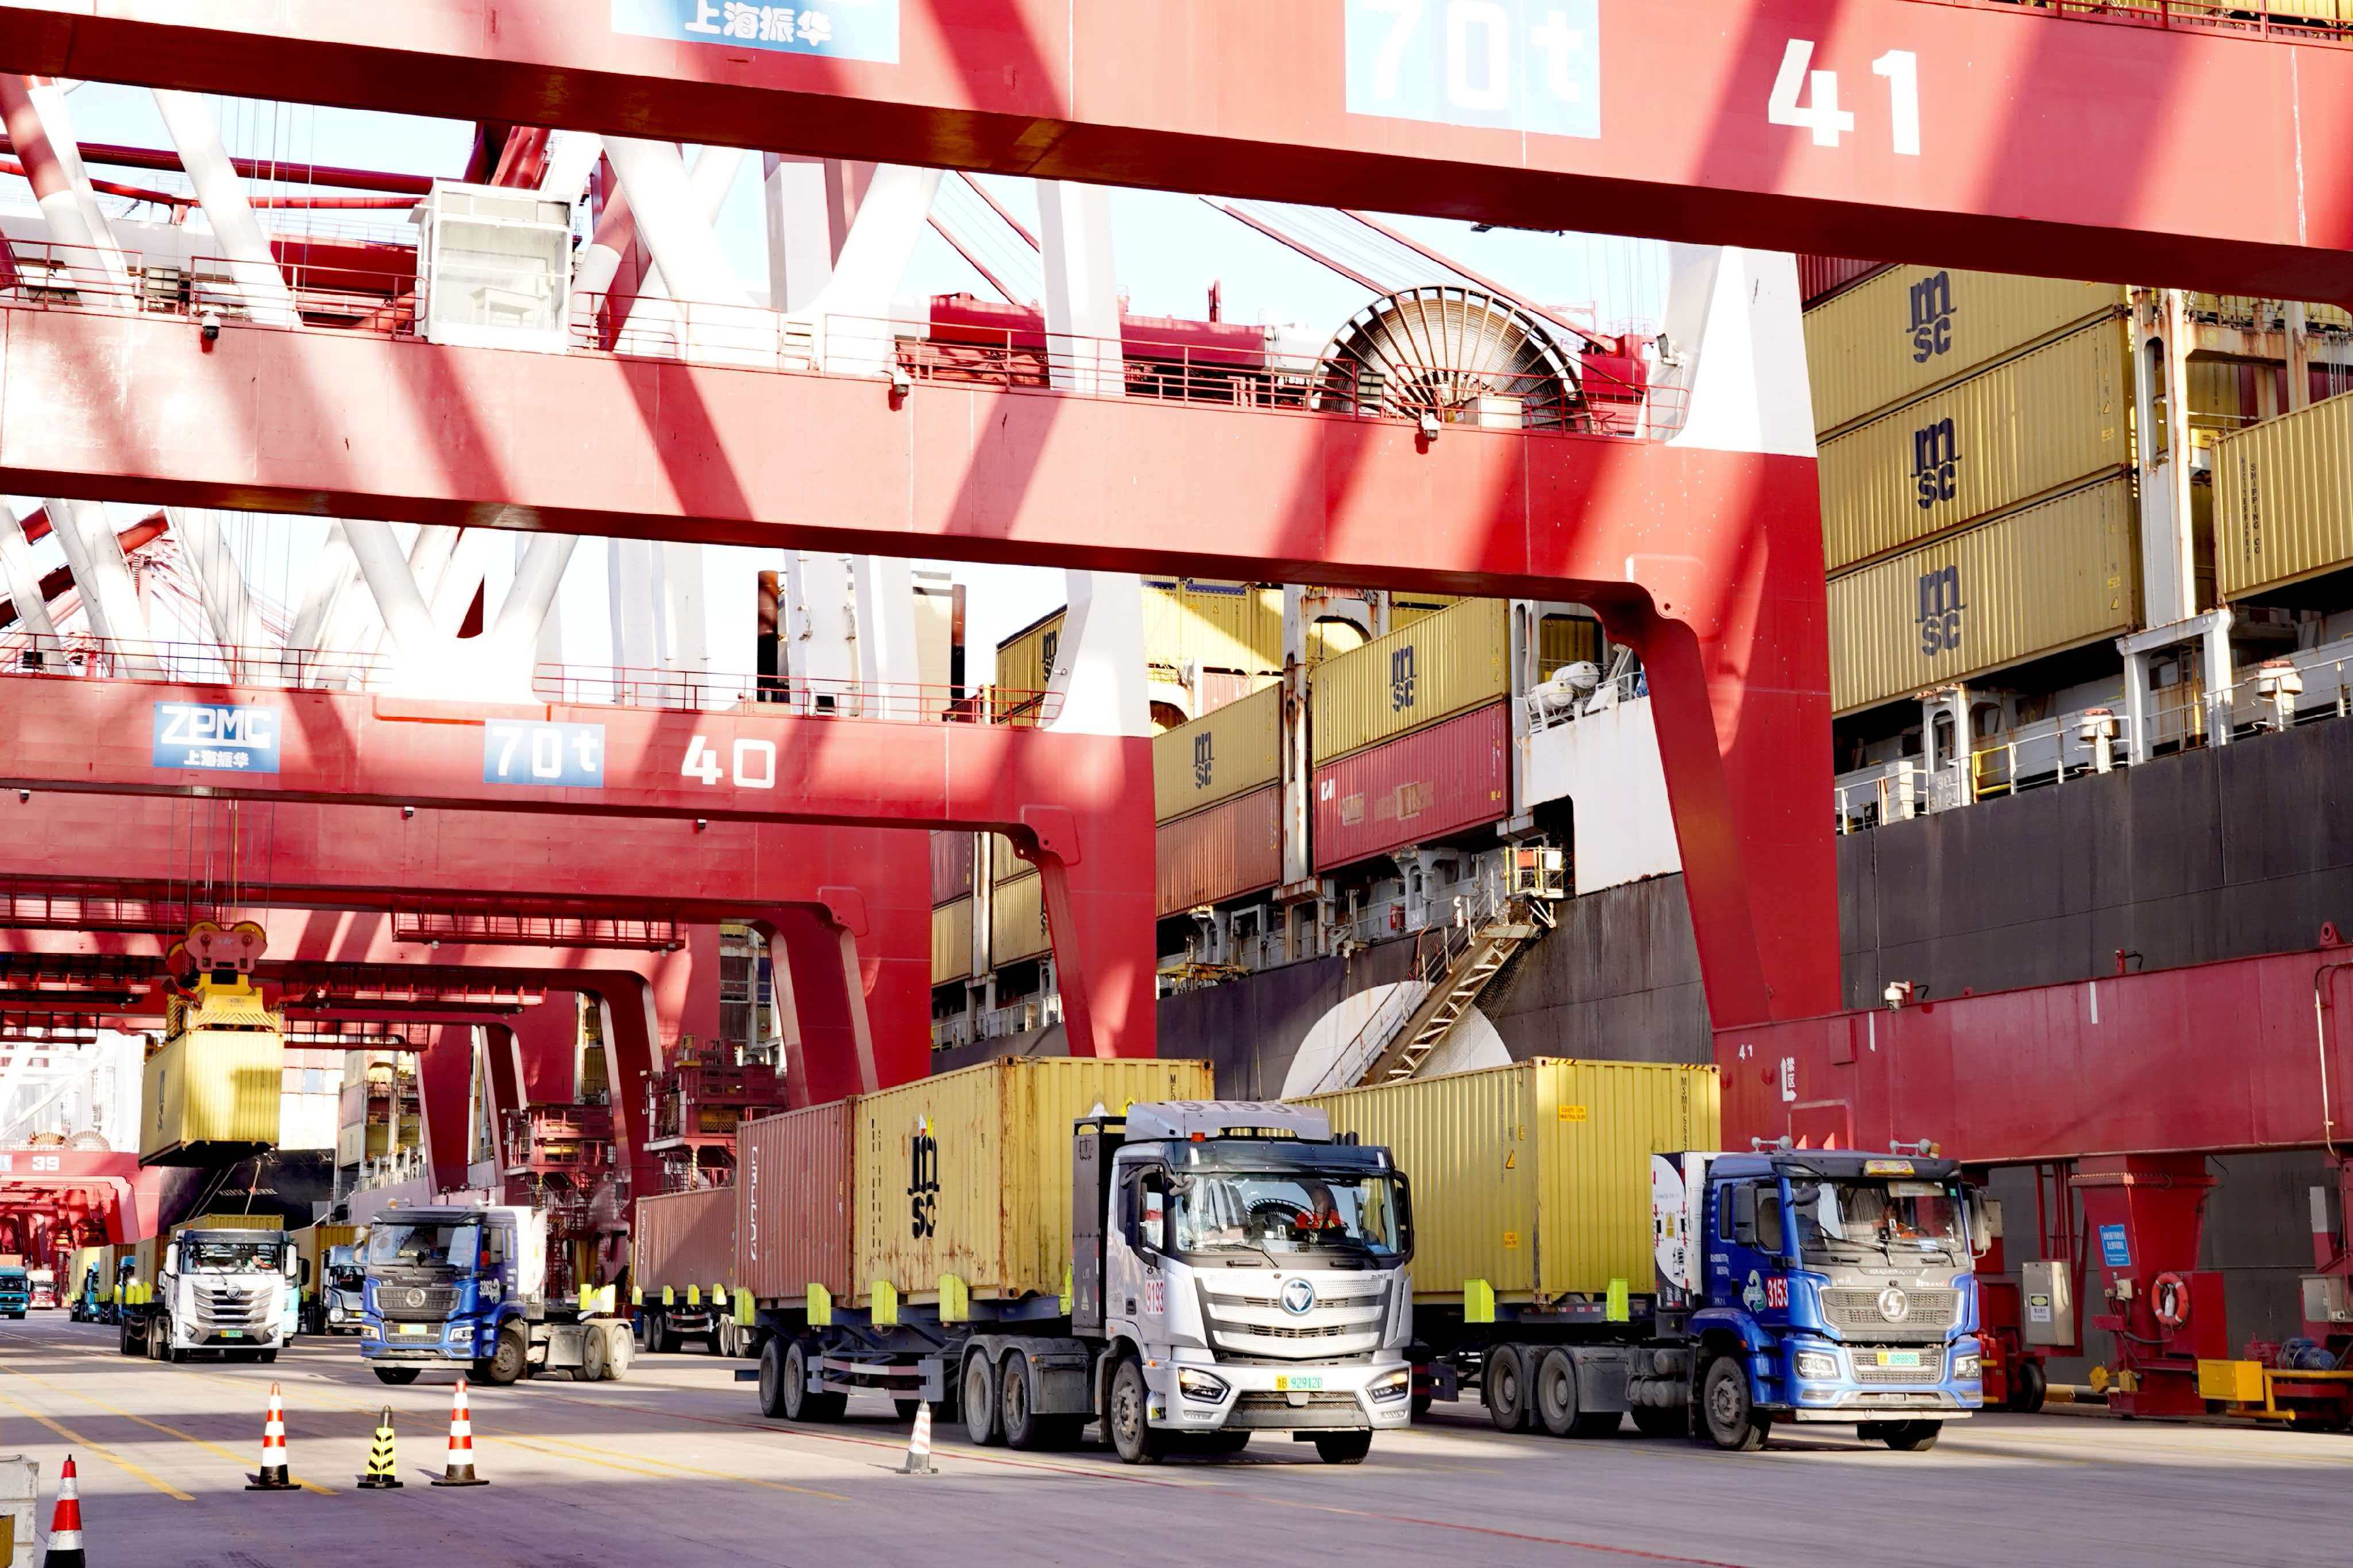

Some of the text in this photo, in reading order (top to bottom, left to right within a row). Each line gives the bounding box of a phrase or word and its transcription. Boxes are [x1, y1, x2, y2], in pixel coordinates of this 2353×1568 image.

[685, 0, 832, 47] 上海振华
[1768, 38, 1920, 156] 41
[161, 705, 272, 748] ZPMC
[184, 750, 249, 768] 上海振华
[492, 725, 599, 778] 70t
[681, 735, 776, 789] 40
[1738, 1044, 1753, 1060] 41
[32, 1156, 60, 1171] 39
[1767, 1278, 1788, 1308] 3153
